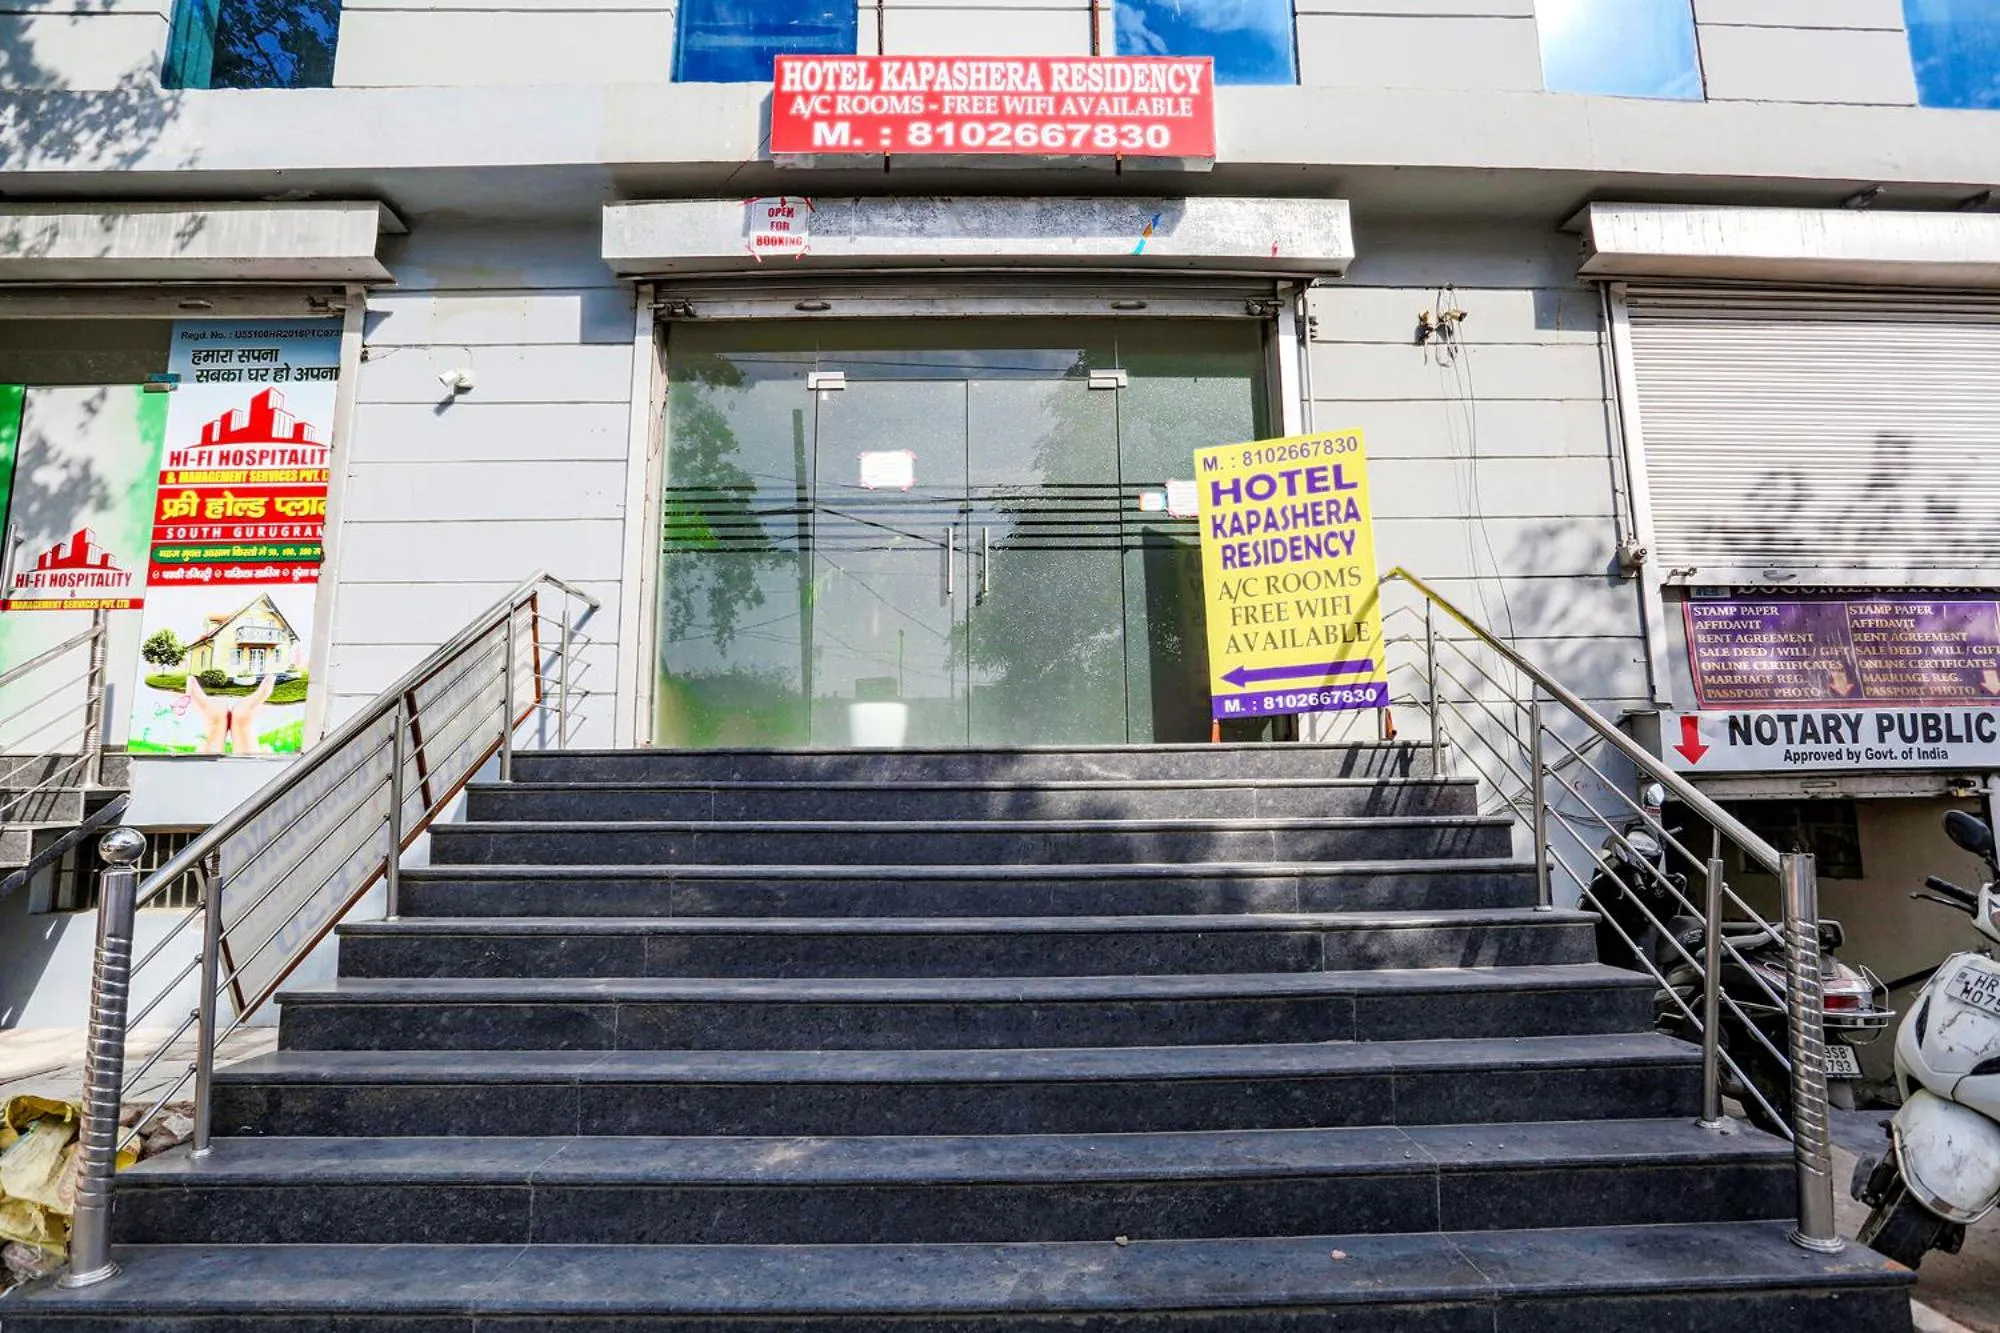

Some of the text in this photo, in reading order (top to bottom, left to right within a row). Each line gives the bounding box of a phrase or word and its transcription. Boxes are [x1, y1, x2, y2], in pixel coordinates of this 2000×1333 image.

[782, 61, 1204, 94] HOTEL KAPASHERA RESIDENCY
[791, 95, 829, 117] A/C
[836, 95, 923, 115] ROOMS
[943, 95, 998, 115] FREE
[1001, 96, 1054, 115] WIFI
[1060, 96, 1193, 117] AVAILABLE
[812, 122, 863, 146] M.
[907, 122, 1171, 148] 8102667830
[768, 207, 794, 218] OPEN
[770, 221, 790, 231] FOR
[756, 235, 802, 246] BOOKING
[191, 348, 280, 366] हमारा सपना
[196, 363, 340, 383] सबका घर हो अपना
[169, 449, 327, 467] HI-FI HOSPITALIT
[1203, 455, 1224, 472] M.
[1242, 436, 1359, 467] 8102667830
[1210, 464, 1359, 507] HOTEL
[161, 490, 201, 520] फ्री
[205, 490, 270, 518] होल्ड
[1211, 497, 1362, 540] KAPASHERA
[167, 526, 222, 540] SOUTH
[1221, 530, 1357, 570] RESIDENCY
[15, 572, 132, 588] HI-FI HOSPITALITY
[1218, 566, 1362, 603] A/C ROOMS
[1231, 595, 1352, 627] FREE WIFI
[1693, 606, 1780, 616] STAMP PAPER
[1849, 605, 1934, 615] STAMP PAPER
[1695, 620, 1762, 630] AFFIDAVIT
[1851, 619, 1916, 629] AFFIDAVIT
[1225, 621, 1371, 655] AVAILABLE
[1697, 633, 1814, 643] RENT AGREEMENT
[1853, 632, 1968, 642] RENT AGREEMENT
[1700, 647, 1731, 657] SALE
[1732, 647, 1768, 657] DEED
[1776, 647, 1811, 657] WILL
[1855, 646, 1887, 655] SALE
[1890, 646, 1922, 655] DEED
[1931, 645, 1965, 655] WILL
[1701, 660, 1843, 671] ONLINE CERTIFICATES
[1860, 659, 1997, 669] ONLINE CERTIFICATES
[1704, 675, 1774, 684] MARRIAGE
[1862, 673, 1930, 682] MARRIAGE
[1706, 687, 1820, 698] PASSPORT PHOTO
[1865, 686, 1976, 696] PASSPORT PHOTO
[1224, 698, 1245, 713] M.
[1263, 688, 1377, 710] 8102667830
[1728, 712, 1997, 746] NOTARY PUBLIC
[1784, 748, 1949, 764] Approved by Govt. of India
[1974, 975, 1999, 993] HR
